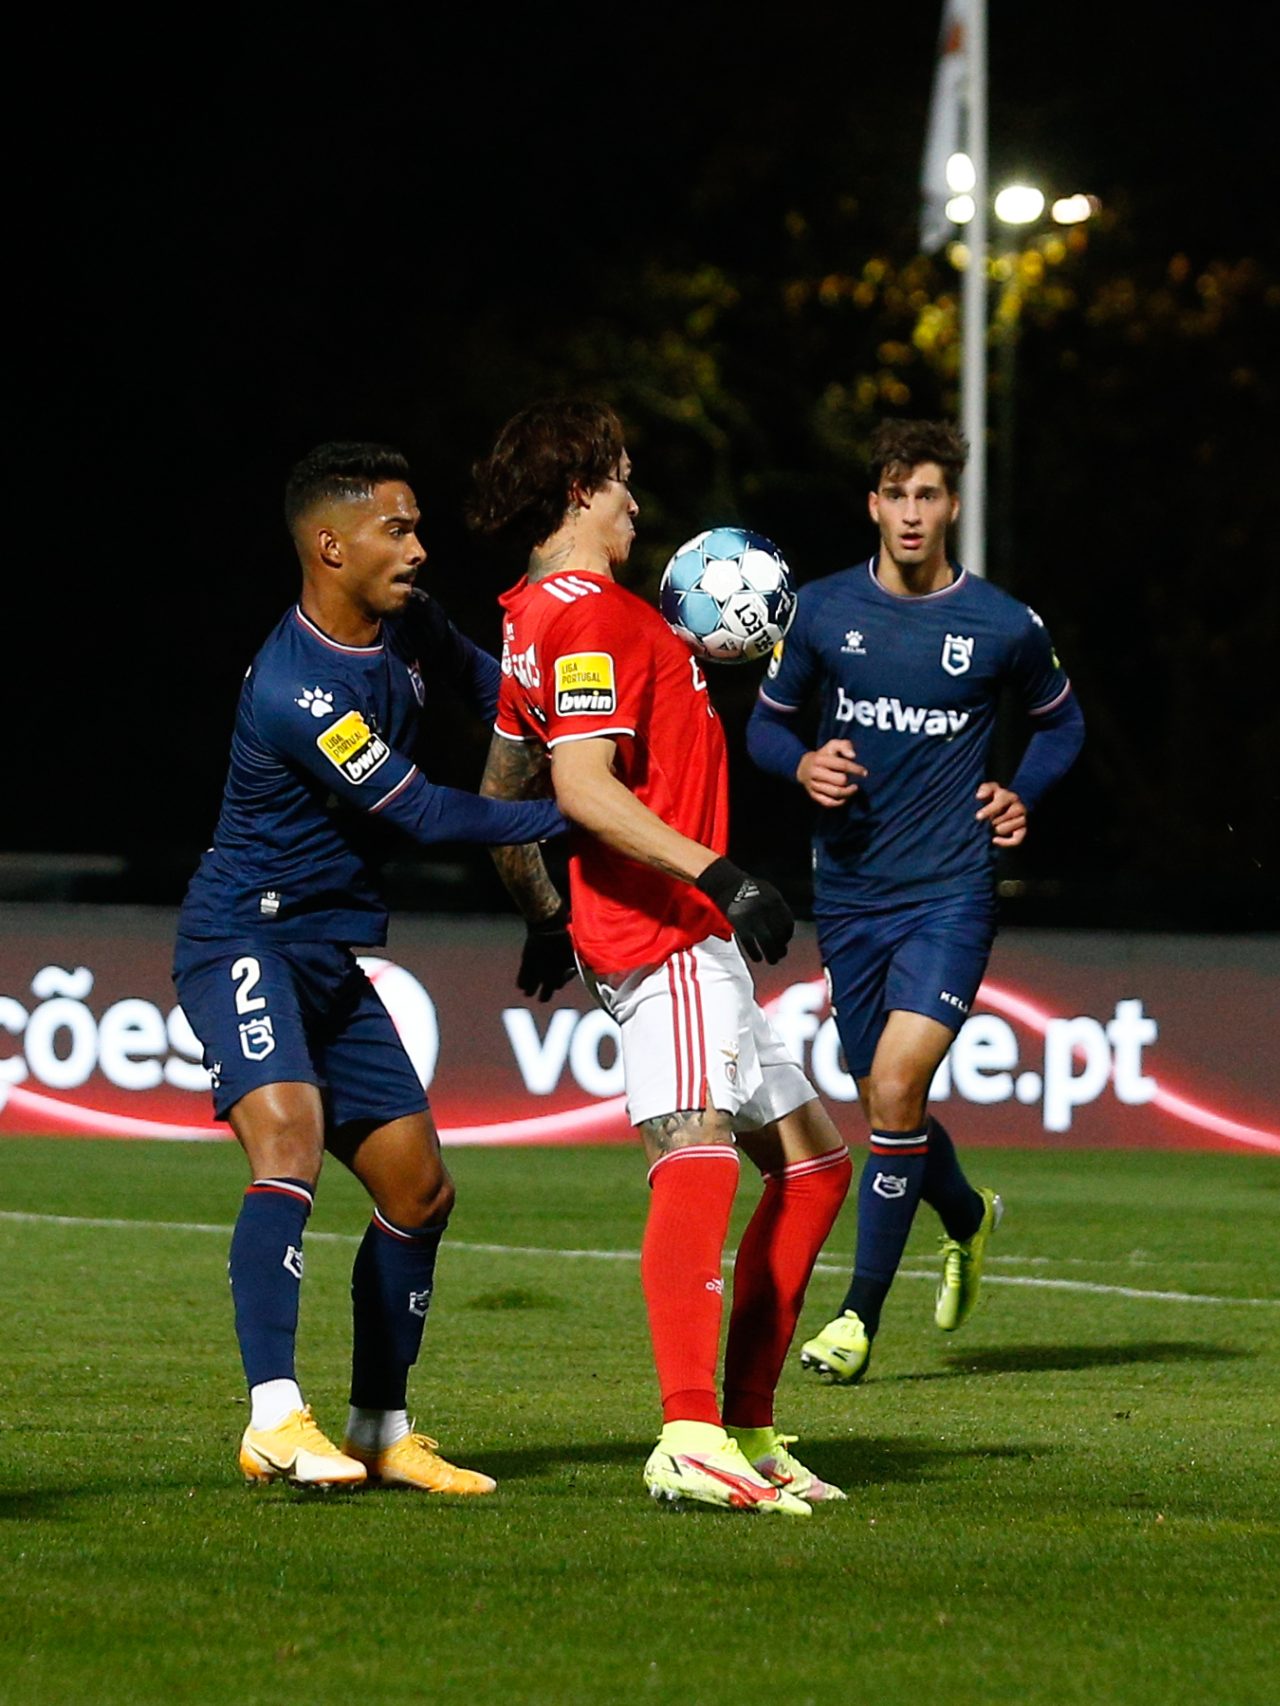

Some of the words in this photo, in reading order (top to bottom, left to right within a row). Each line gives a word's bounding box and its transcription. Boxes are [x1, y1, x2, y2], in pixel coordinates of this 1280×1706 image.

[734, 604, 774, 653] SELECT
[562, 662, 578, 675] LIGA
[562, 671, 601, 685] PORTUGAL
[560, 690, 612, 712] bwin
[835, 687, 970, 742] betway
[325, 733, 344, 750] LIGA
[345, 740, 386, 780] bwin
[231, 956, 267, 1016] 2
